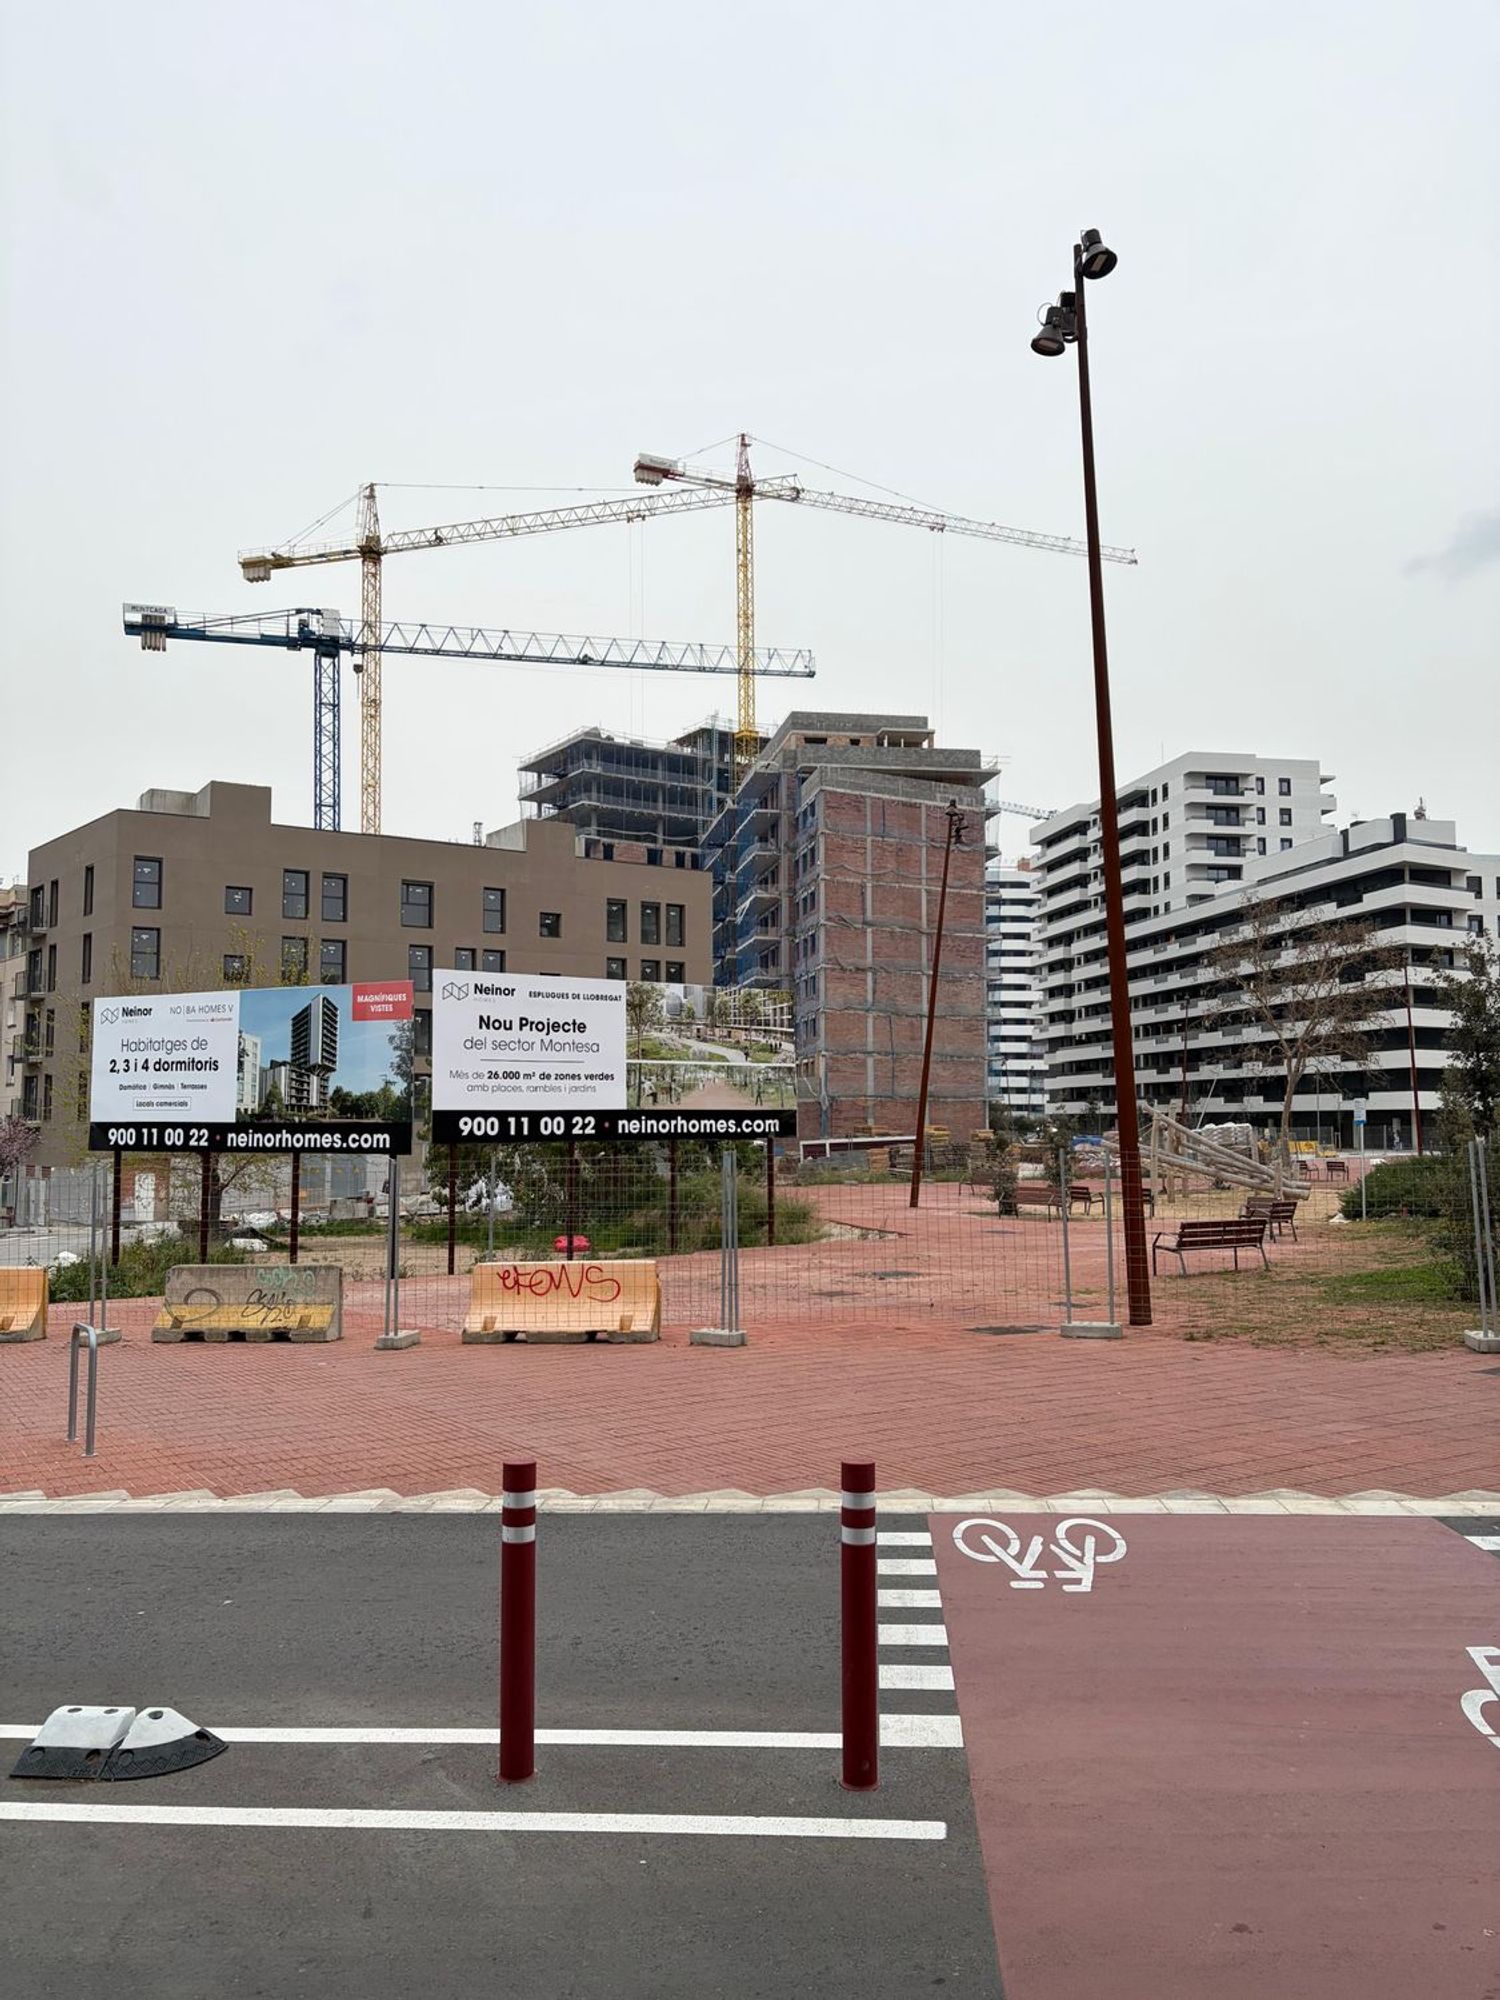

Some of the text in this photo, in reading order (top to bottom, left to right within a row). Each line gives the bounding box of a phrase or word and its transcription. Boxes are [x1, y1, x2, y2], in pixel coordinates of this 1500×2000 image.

[473, 982, 516, 997] Neinor
[572, 993, 581, 1001] DE
[122, 1005, 153, 1018] Neinor
[199, 1004, 225, 1014] HOMES
[478, 1014, 587, 1036] Nou Projecte
[121, 1036, 208, 1055] Habitatges de
[463, 1037, 600, 1053] del sector Montesa
[109, 1058, 120, 1074] 2,
[122, 1059, 131, 1073] 3
[141, 1058, 149, 1072] 4
[153, 1057, 219, 1072] dormitoris
[473, 1070, 485, 1080] de
[487, 1071, 521, 1080] 26.000
[539, 1071, 552, 1081] de
[584, 1072, 615, 1081] verdes
[466, 1084, 489, 1093] amb
[526, 1084, 562, 1093] rambles
[156, 1100, 188, 1108] comercials
[458, 1116, 780, 1136] 900 11 00 22 neinorhomes.com
[107, 1127, 391, 1149] 900 11 00 22 neinorhomes.com
